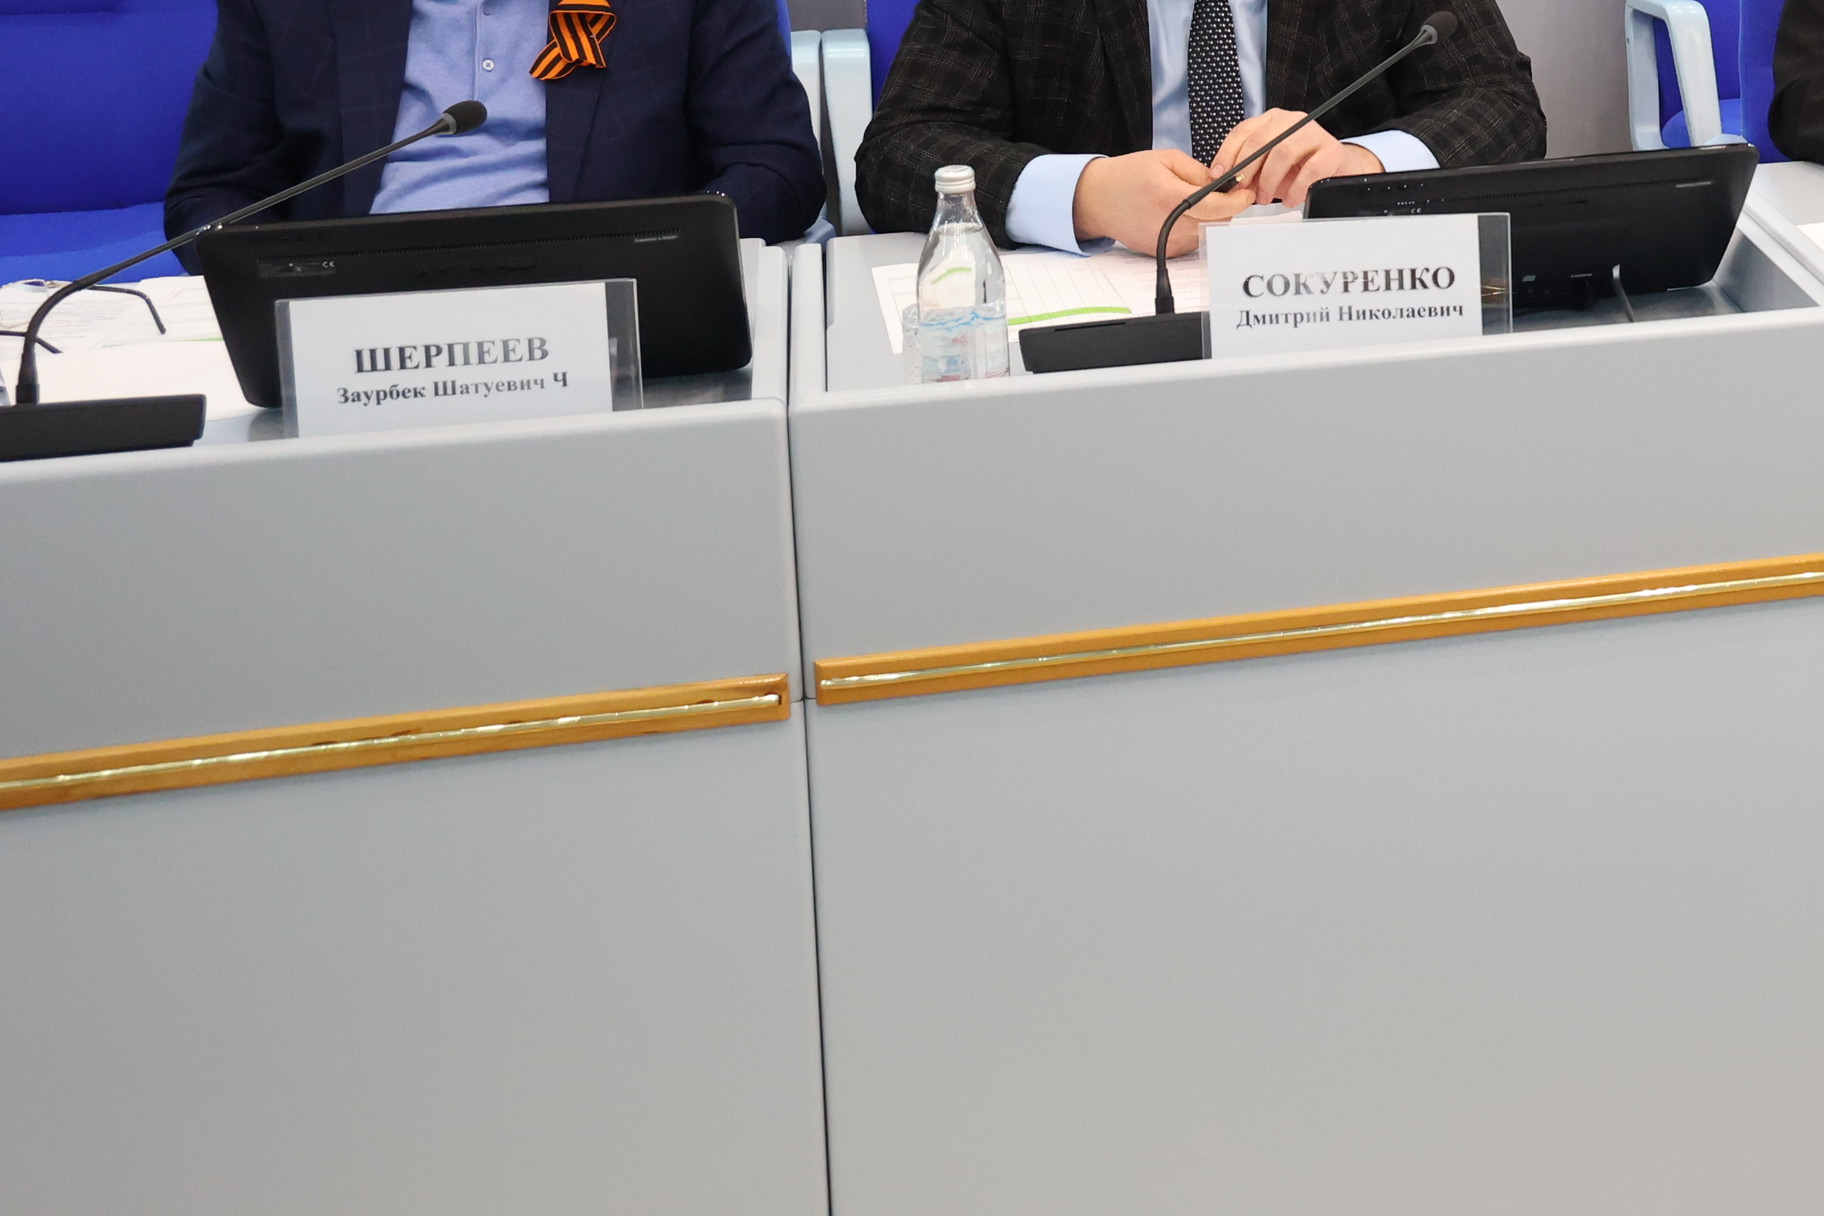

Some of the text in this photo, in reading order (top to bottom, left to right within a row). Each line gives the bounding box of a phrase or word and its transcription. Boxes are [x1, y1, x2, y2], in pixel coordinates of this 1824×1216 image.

[1242, 266, 1456, 298] СОКУРЕНКО
[1235, 305, 1464, 330] Дмитрий Николаевич
[353, 336, 550, 374] ШЕРПЕЕВ
[336, 370, 569, 407] Заурбек Шатуевич Ч
